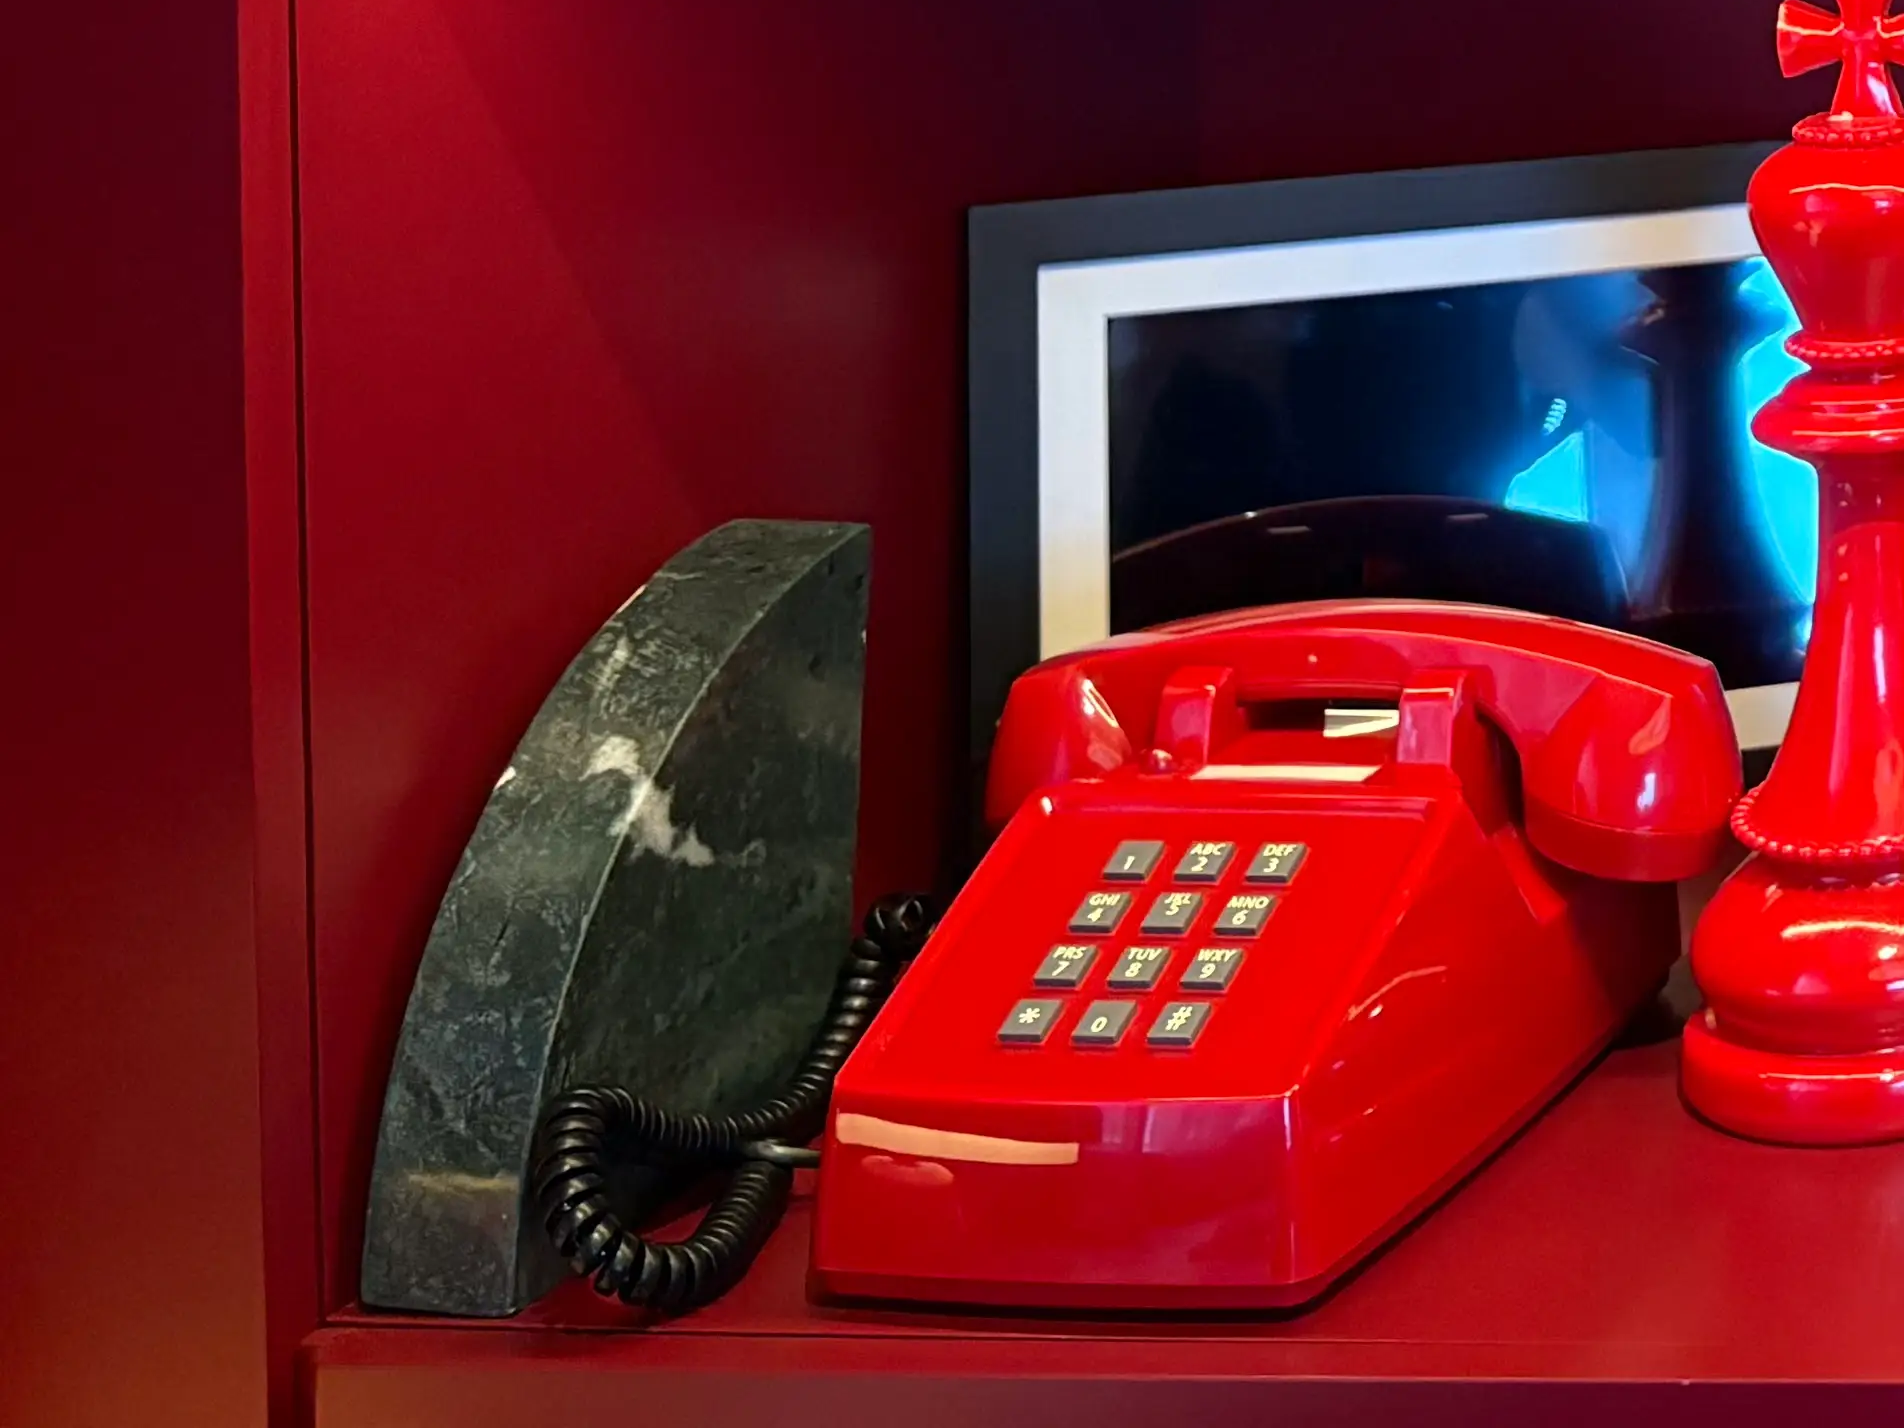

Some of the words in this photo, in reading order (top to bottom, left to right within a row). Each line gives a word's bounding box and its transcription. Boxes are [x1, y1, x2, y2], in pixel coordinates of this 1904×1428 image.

[1189, 842, 1227, 856] ABC
[1262, 844, 1298, 857] DEF
[1123, 855, 1136, 871] 1
[1191, 856, 1209, 872] 2
[1262, 857, 1280, 873] 3
[1165, 903, 1181, 916] 5
[1226, 896, 1270, 909] MNO
[1087, 907, 1104, 923] 4
[1231, 909, 1249, 925] 6
[1052, 946, 1087, 960] PRS
[1127, 947, 1162, 961] TUV
[1197, 948, 1237, 962] WXY
[1051, 961, 1070, 977] 7
[1124, 962, 1143, 978] 8
[1199, 963, 1217, 979] 9
[1089, 1016, 1109, 1033] 0
